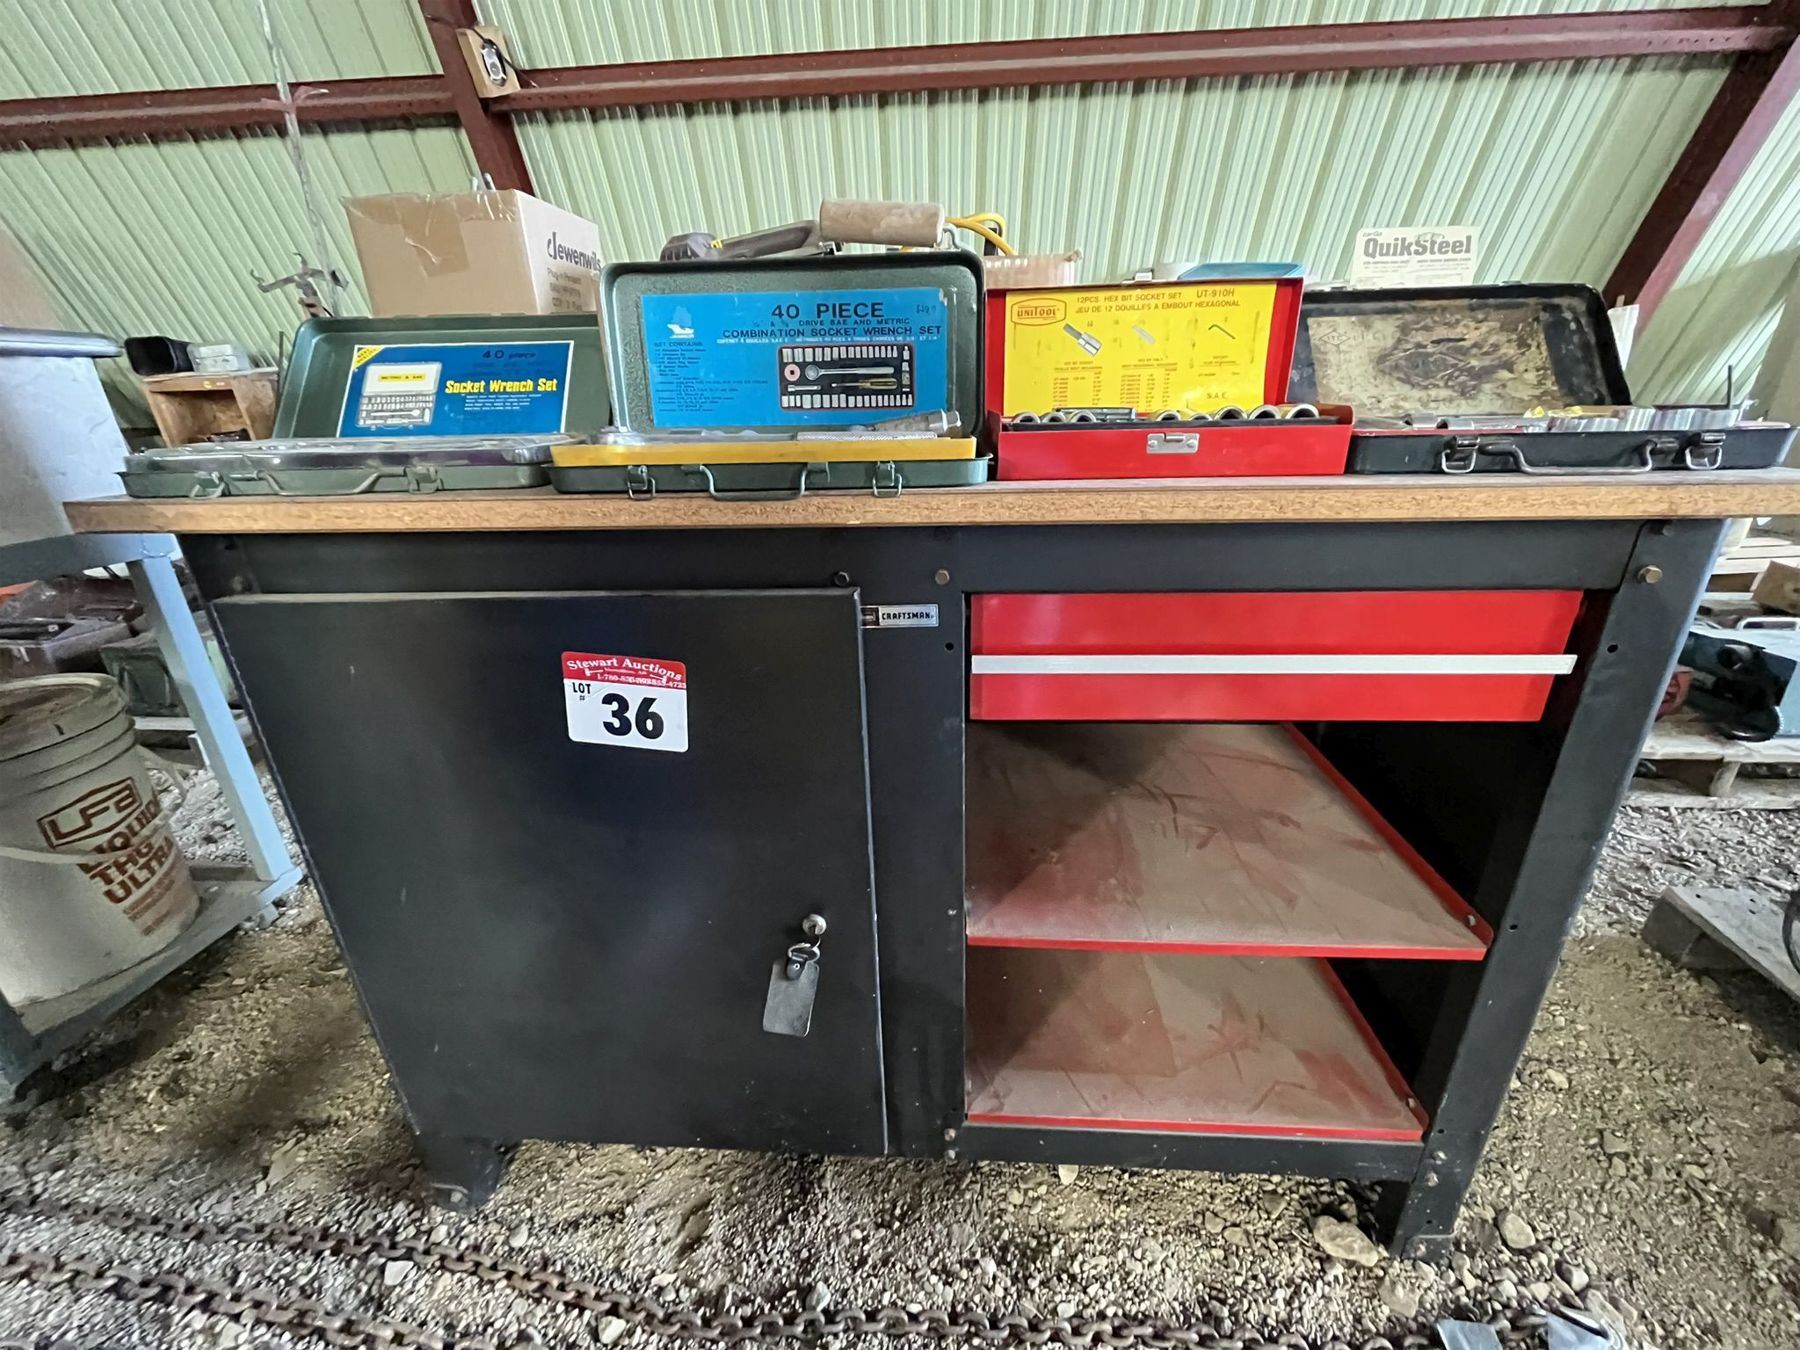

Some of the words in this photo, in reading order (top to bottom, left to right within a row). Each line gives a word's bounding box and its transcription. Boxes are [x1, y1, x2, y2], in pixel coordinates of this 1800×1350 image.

[1363, 235, 1472, 259] QuikSteel
[1196, 288, 1235, 298] UT-910H
[771, 304, 800, 319] 40
[816, 302, 885, 318] PIECE
[1161, 301, 1193, 309] EMBOUT
[798, 319, 825, 327] DRIVE
[722, 328, 805, 338] COMBINATION
[811, 327, 857, 337] SOCKET
[863, 326, 912, 336] WRENCH
[919, 325, 942, 335] SET
[482, 350, 504, 359] 40
[445, 380, 486, 394] Socket
[489, 379, 534, 393] Wrench
[537, 378, 558, 392] Set
[881, 611, 932, 620] CRAFTSMAN
[567, 657, 618, 670] Stewart
[622, 658, 683, 682] Auctions
[572, 682, 591, 695] LOT
[602, 693, 664, 739] 36
